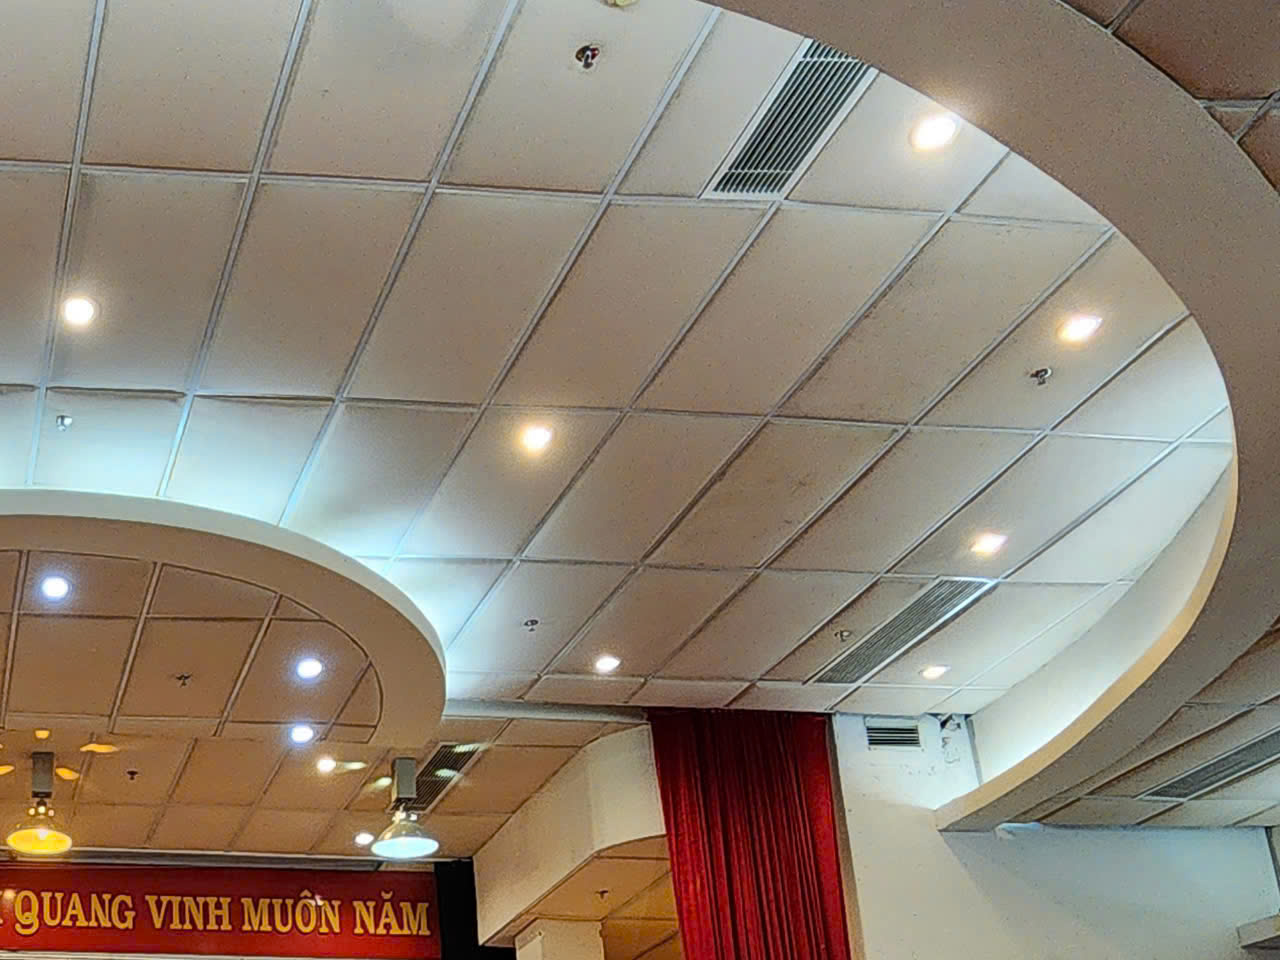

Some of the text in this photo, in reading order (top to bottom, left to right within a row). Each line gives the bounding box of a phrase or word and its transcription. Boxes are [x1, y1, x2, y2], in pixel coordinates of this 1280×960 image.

[12, 890, 136, 936] QUANG
[145, 895, 233, 932] VINH
[241, 889, 342, 934] MUÔN
[353, 889, 431, 937] NĂM
